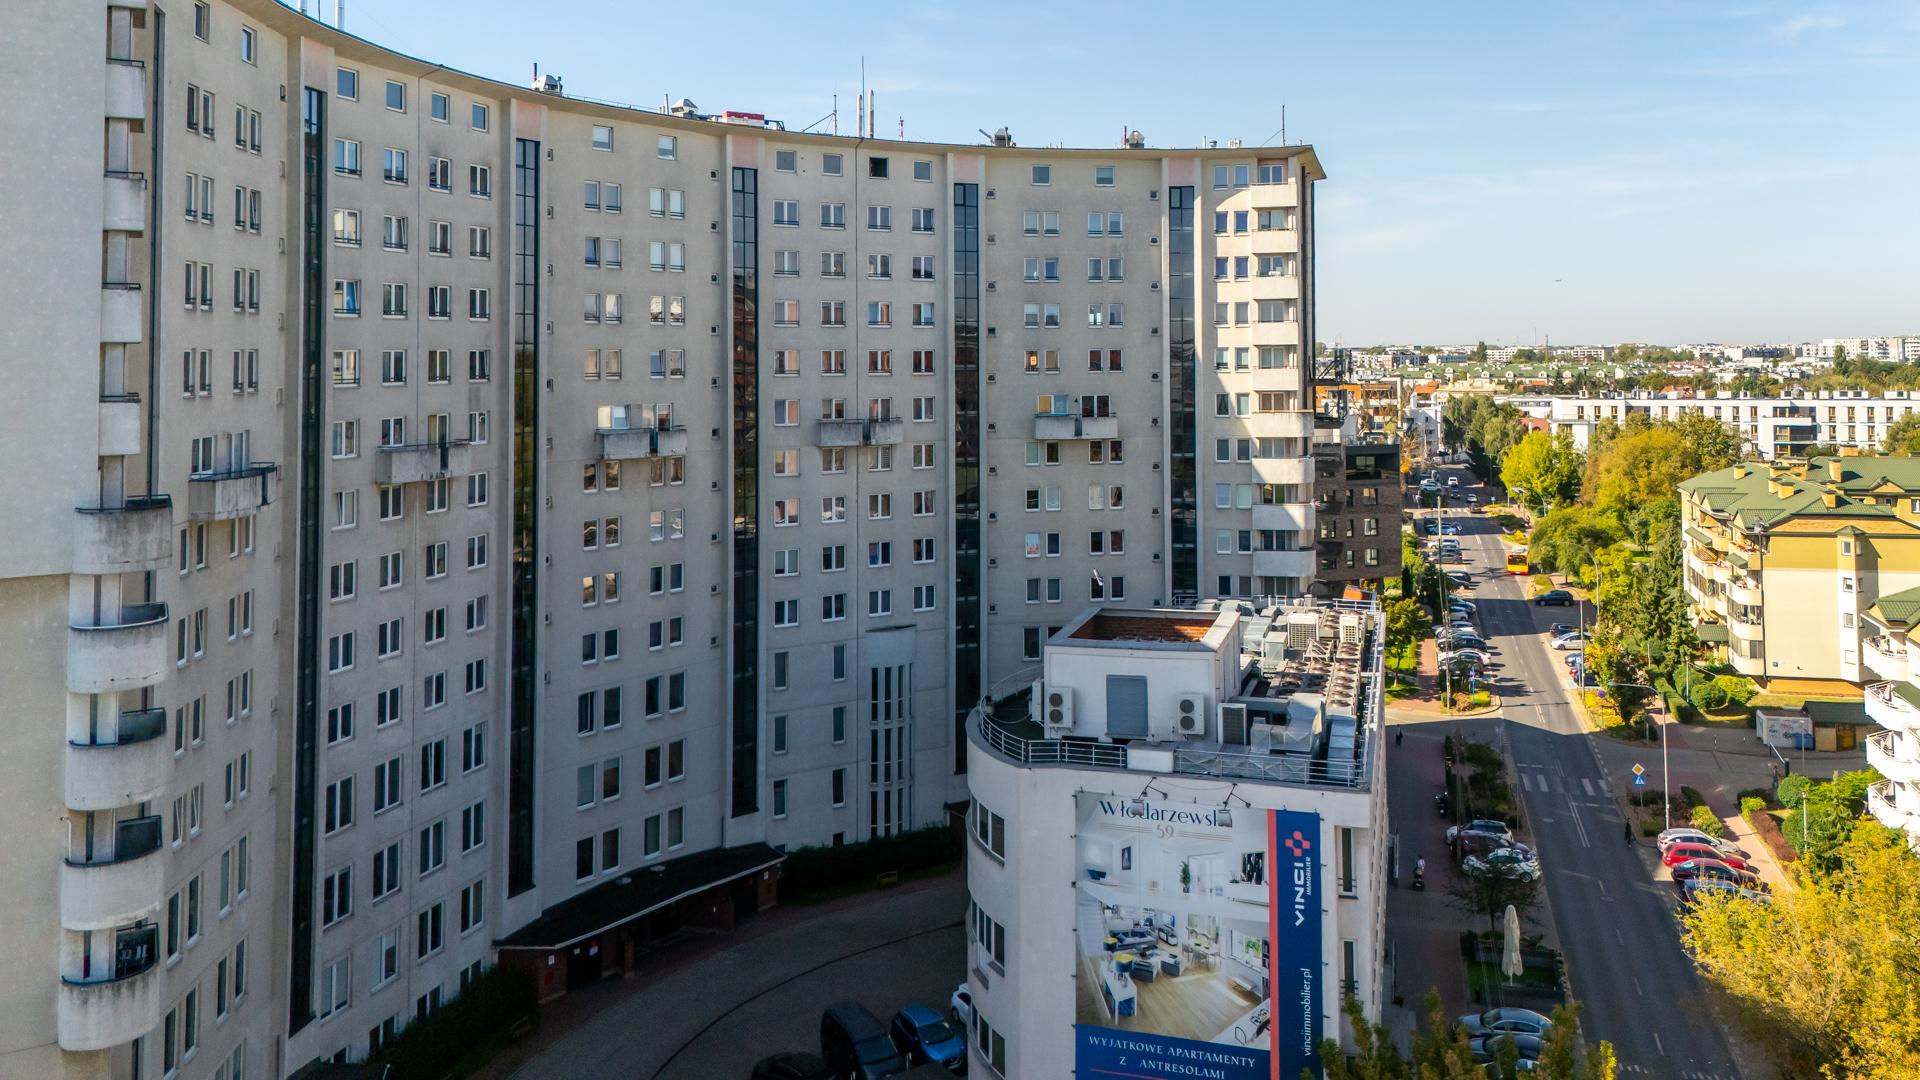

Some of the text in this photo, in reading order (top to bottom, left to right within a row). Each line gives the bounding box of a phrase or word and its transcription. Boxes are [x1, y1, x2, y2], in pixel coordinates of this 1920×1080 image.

[1099, 799, 1217, 827] Włodarzews
[1155, 823, 1175, 840] 59
[1294, 862, 1305, 927] VINCI
[1300, 968, 1313, 1057] vinciimmobilier.pl
[1119, 1056, 1225, 1080] Z ANTRESOLAMI
[1167, 1047, 1256, 1068] APARTAMENTY
